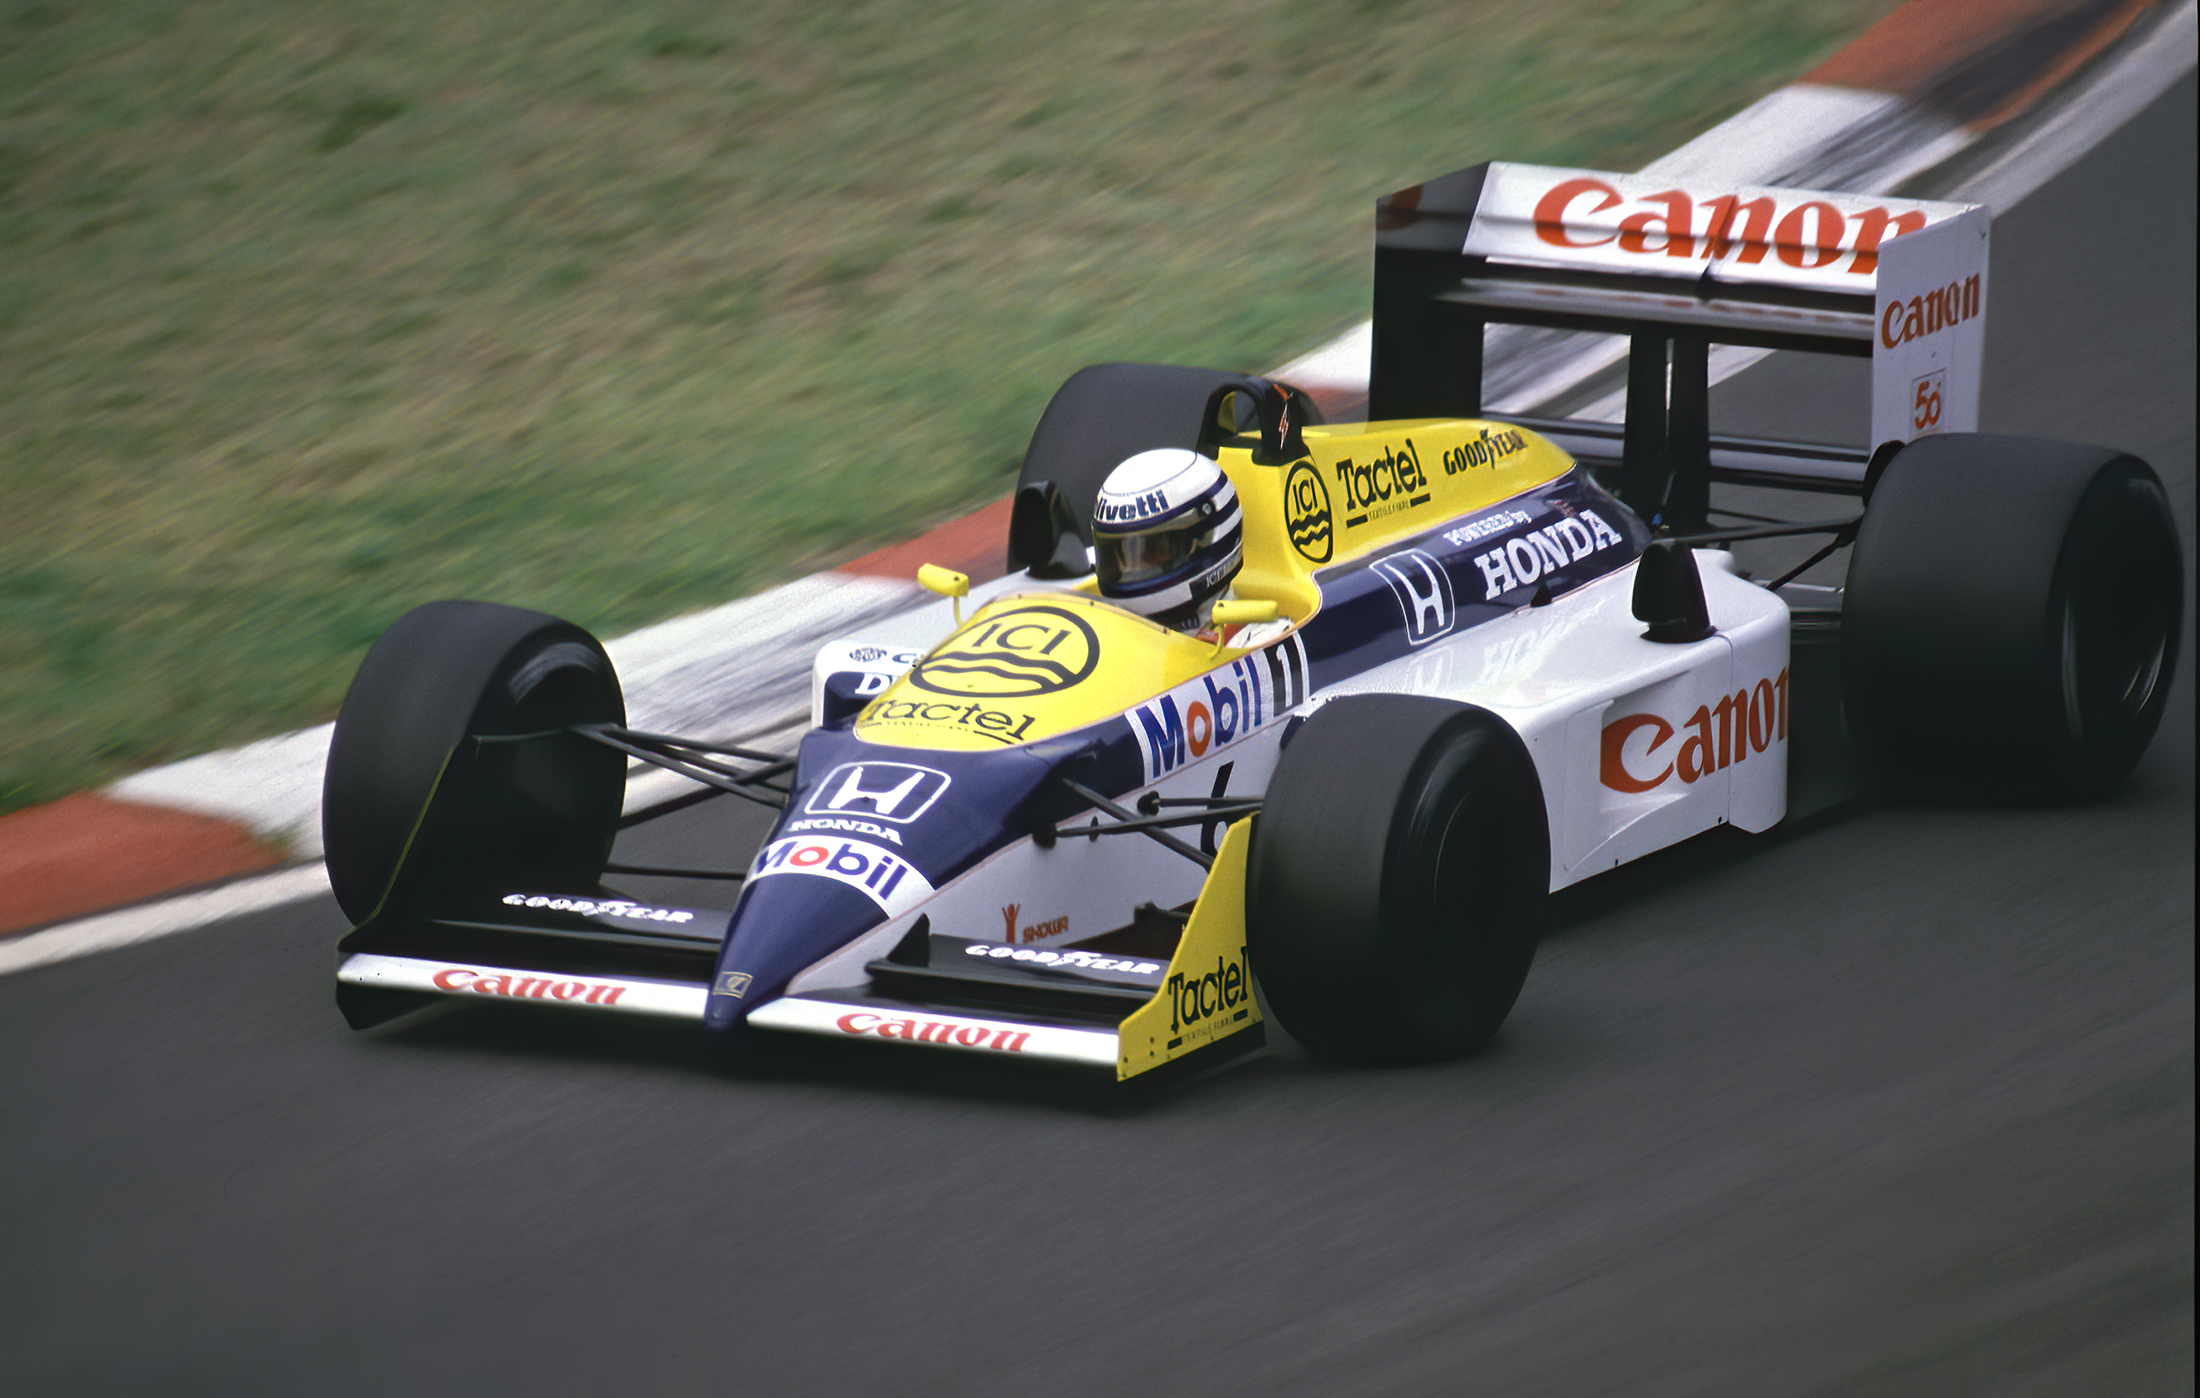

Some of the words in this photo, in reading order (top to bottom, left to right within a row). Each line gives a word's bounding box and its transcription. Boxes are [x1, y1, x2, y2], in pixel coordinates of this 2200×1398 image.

[1881, 273, 1980, 349] Canon
[1336, 438, 1427, 512] Tactel
[1293, 478, 1316, 514] ICI
[1473, 509, 1622, 600] HONDA
[972, 622, 1072, 656] ICI
[1135, 655, 1262, 779] Mobil
[1276, 643, 1293, 708] 1
[787, 819, 903, 846] HONDA
[756, 840, 908, 901] Mobil
[502, 894, 693, 923] GOODYEAR
[965, 945, 1160, 975] GOODYEAR
[433, 969, 627, 1005] Canon
[1168, 946, 1248, 1034] Tactel
[836, 1013, 1031, 1052] Canon
